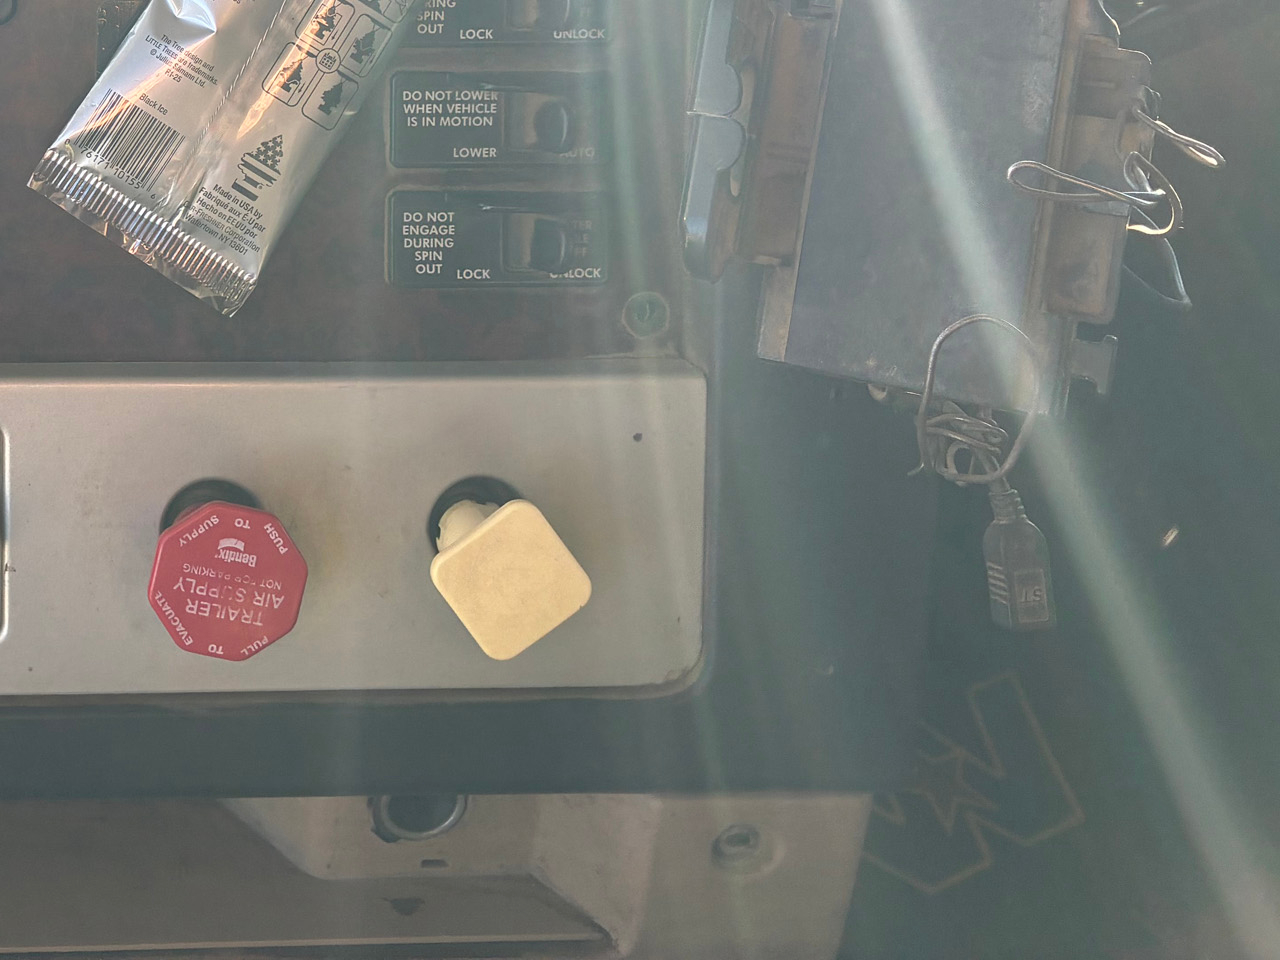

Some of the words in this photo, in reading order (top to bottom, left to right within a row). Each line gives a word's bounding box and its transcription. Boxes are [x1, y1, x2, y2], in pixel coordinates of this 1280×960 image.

[417, 23, 444, 34] OUT
[460, 29, 493, 39] LOCK
[553, 28, 605, 39] UNLOCK
[161, 34, 172, 45] The
[172, 41, 185, 53] Tree
[202, 61, 215, 72] and
[145, 35, 162, 49] LITTLE
[163, 46, 178, 60] TREES
[188, 61, 218, 86] trademarks.
[402, 91, 421, 101] DO
[424, 91, 452, 101] NOT
[455, 91, 498, 101] LOWER
[139, 93, 158, 109] Black
[157, 103, 168, 115] Ice
[403, 104, 443, 114] WHEN
[446, 104, 497, 114] VEHICLE
[407, 117, 418, 127] IS
[421, 117, 436, 127] IN
[439, 116, 493, 127] MOTION
[453, 147, 497, 158] LOWER
[80, 146, 110, 170] 76171
[113, 169, 142, 190] 10155
[199, 187, 230, 210] Fabriqué
[228, 206, 242, 217] aux
[213, 183, 233, 200] Made
[239, 200, 254, 214] USA
[253, 209, 264, 220] by
[196, 197, 218, 215] Hecho
[227, 215, 246, 232] EEUU
[403, 213, 423, 223] DO
[427, 212, 455, 223] NOT
[402, 225, 455, 236] ENGAGE
[219, 233, 231, 244] NY
[224, 226, 260, 253] Corporation
[403, 238, 454, 249] DURING
[414, 251, 443, 261] SPIN
[415, 264, 442, 274] OUT
[457, 269, 490, 279] LOCK
[234, 518, 251, 530] TO
[178, 515, 220, 547] SUPPLY
[263, 523, 289, 555] PUSH
[219, 548, 257, 567] Bendix
[260, 579, 282, 590] NOT
[253, 591, 285, 609] AIR
[154, 590, 194, 646] EVACUATE
[185, 598, 264, 626] TRAILER
[207, 643, 224, 655] TO
[240, 635, 269, 656] PULL
